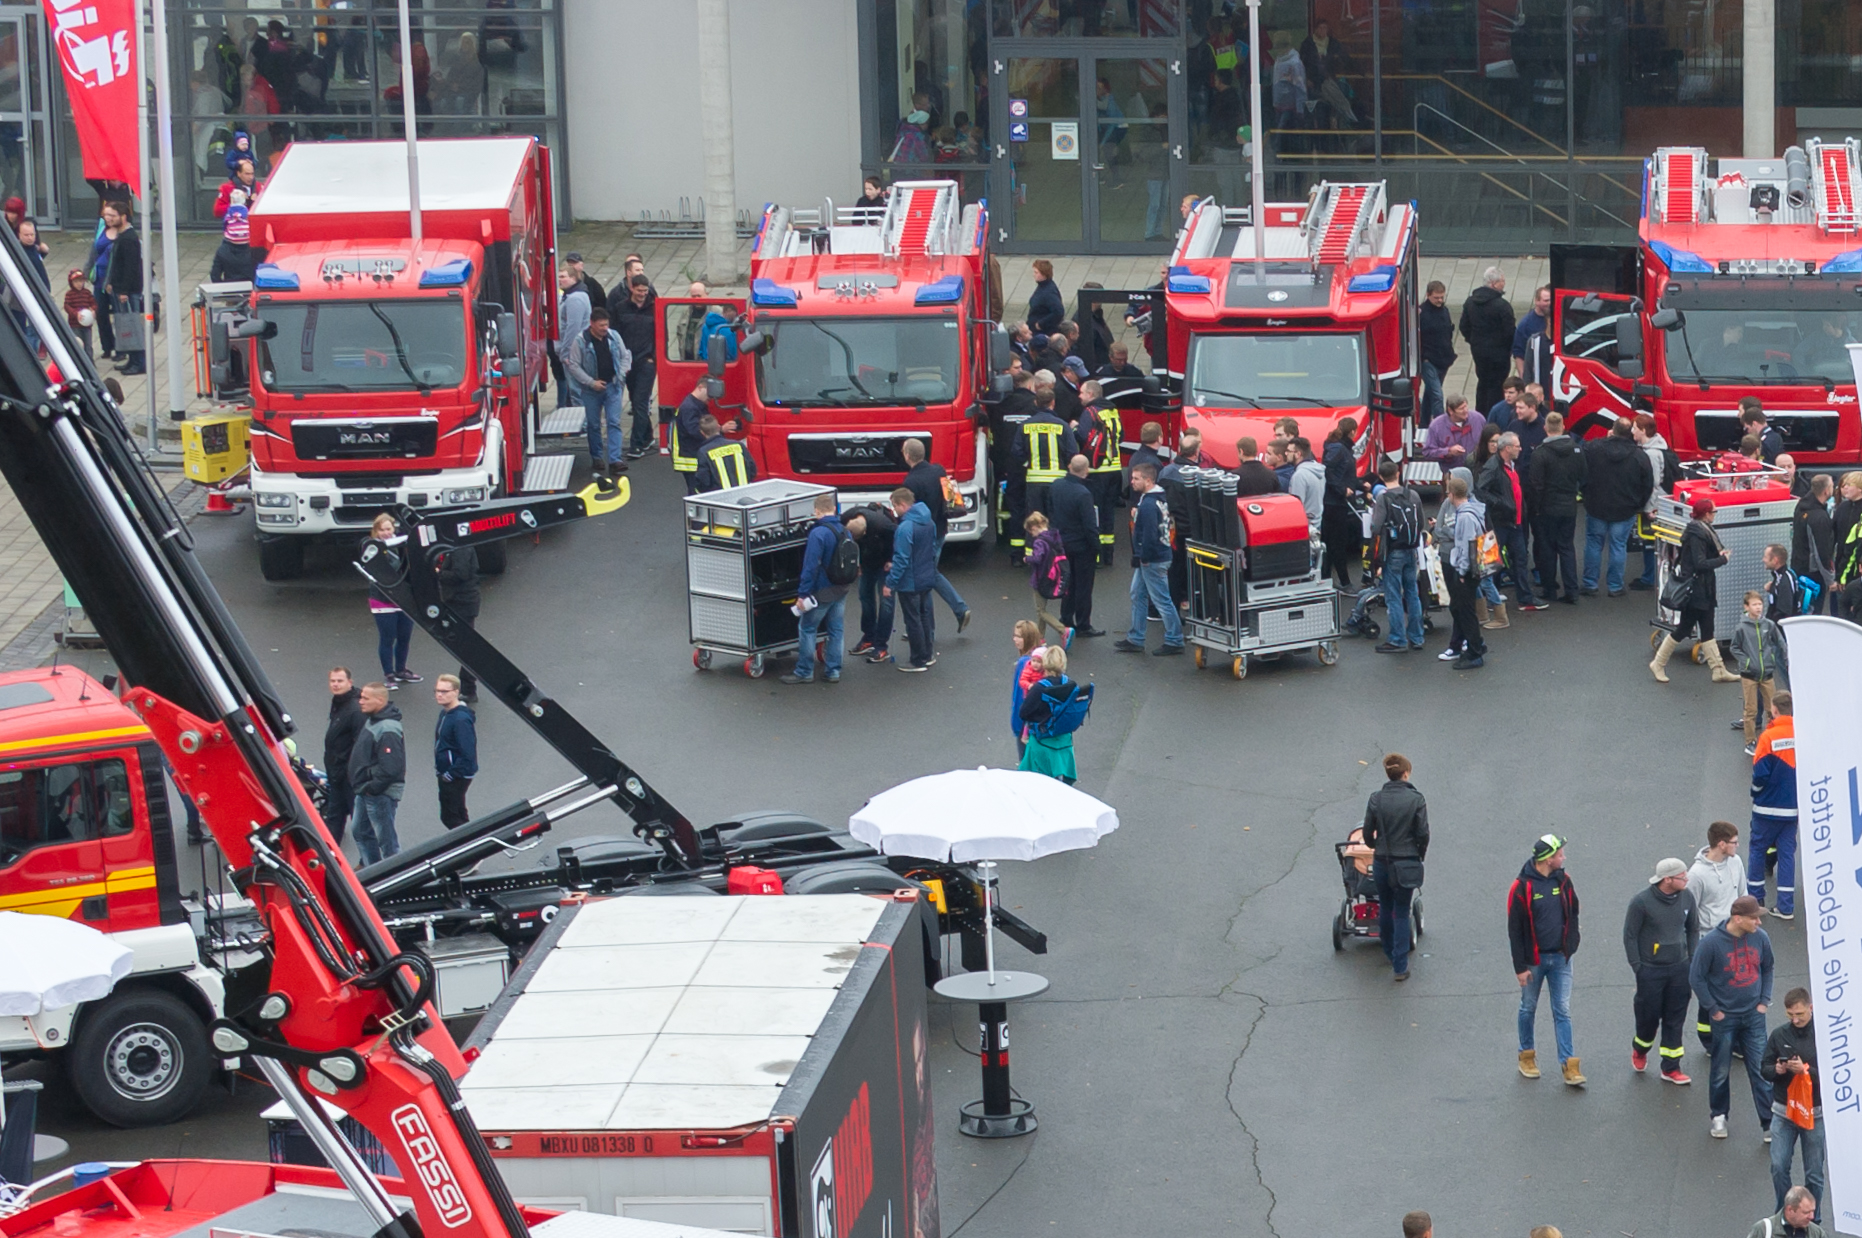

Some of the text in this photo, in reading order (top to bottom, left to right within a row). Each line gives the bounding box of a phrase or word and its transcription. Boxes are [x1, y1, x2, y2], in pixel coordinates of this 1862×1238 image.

[340, 432, 390, 444] MAN
[835, 447, 885, 458] MAN
[540, 1137, 653, 1154] MBXU 081338 0
[401, 1110, 466, 1224] FASSI
